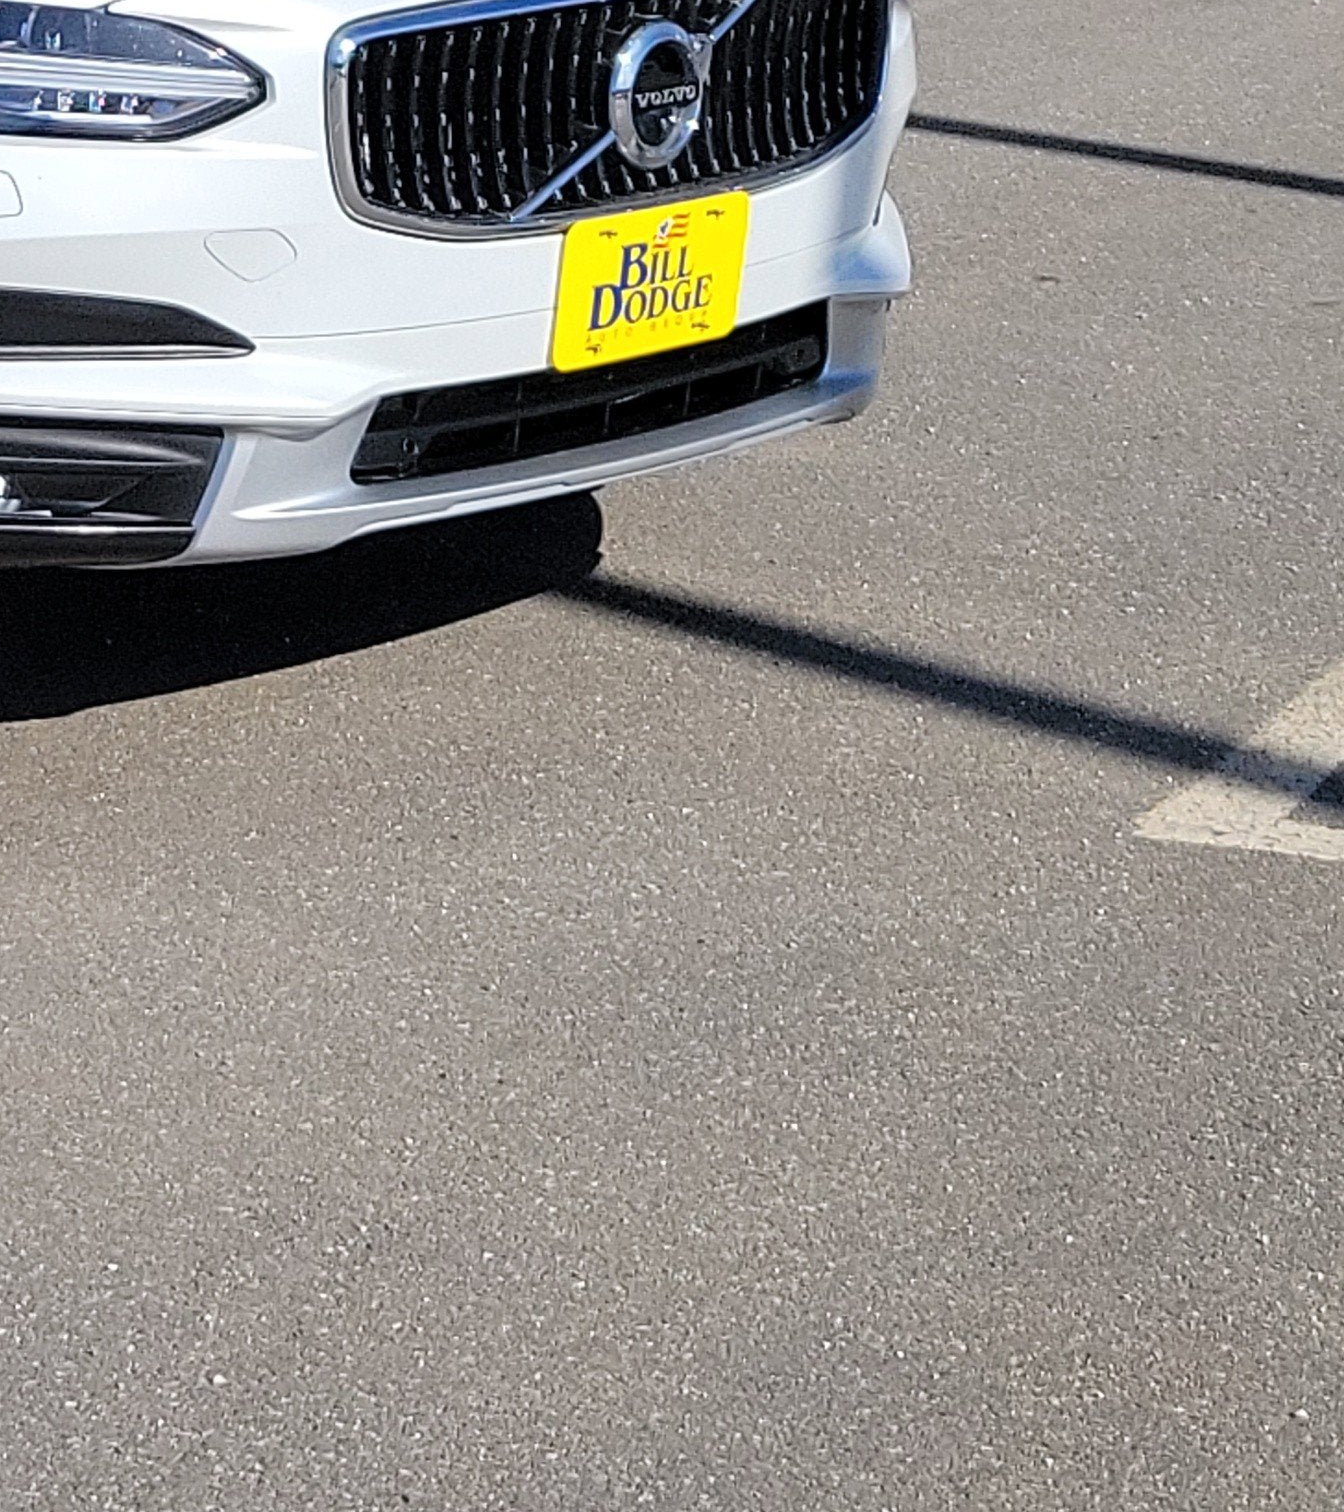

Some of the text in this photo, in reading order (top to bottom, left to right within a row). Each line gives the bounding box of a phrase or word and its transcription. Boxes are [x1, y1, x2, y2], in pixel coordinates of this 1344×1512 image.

[634, 84, 697, 109] VOLVO
[618, 242, 695, 290] BILL
[587, 273, 713, 332] DODGE
